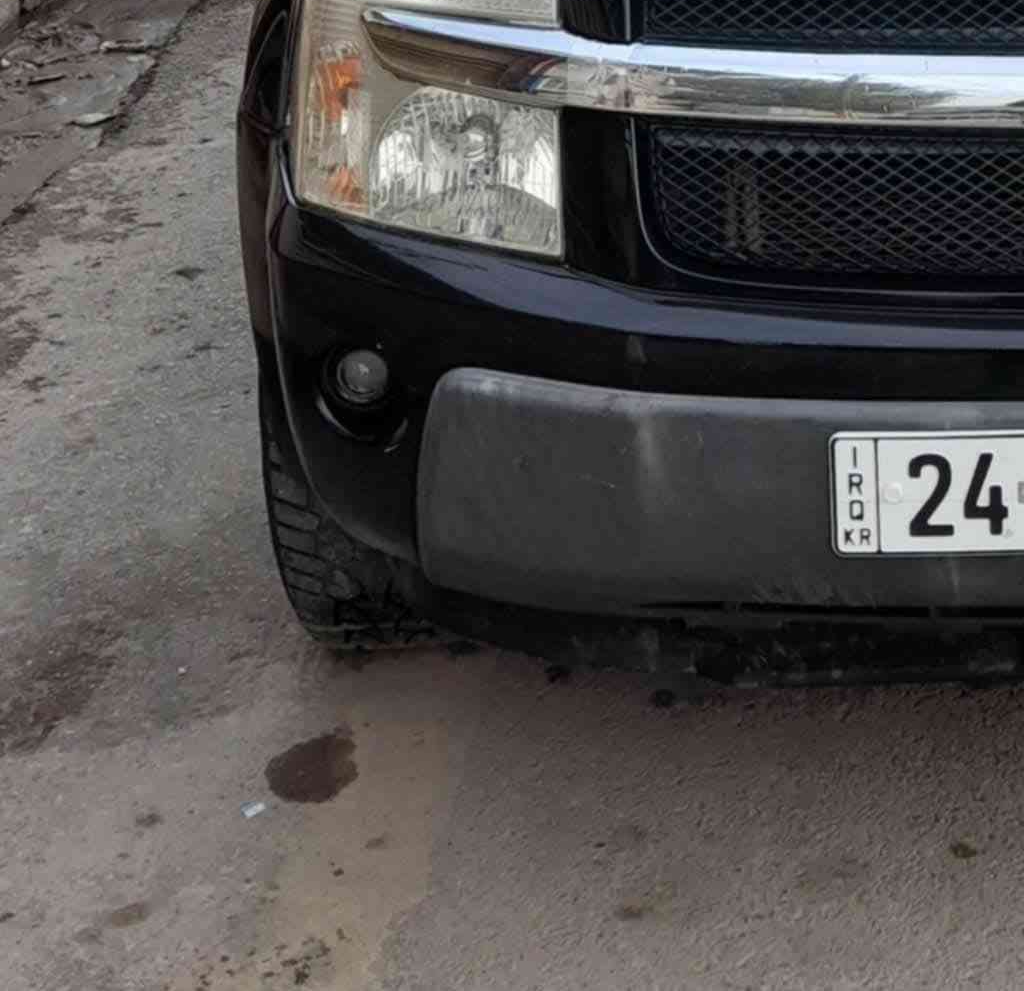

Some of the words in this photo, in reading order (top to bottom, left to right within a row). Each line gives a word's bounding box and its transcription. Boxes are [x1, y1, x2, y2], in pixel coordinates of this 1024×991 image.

[848, 446, 864, 521] IRQ
[908, 453, 1009, 537] 24
[843, 528, 871, 545] KR
